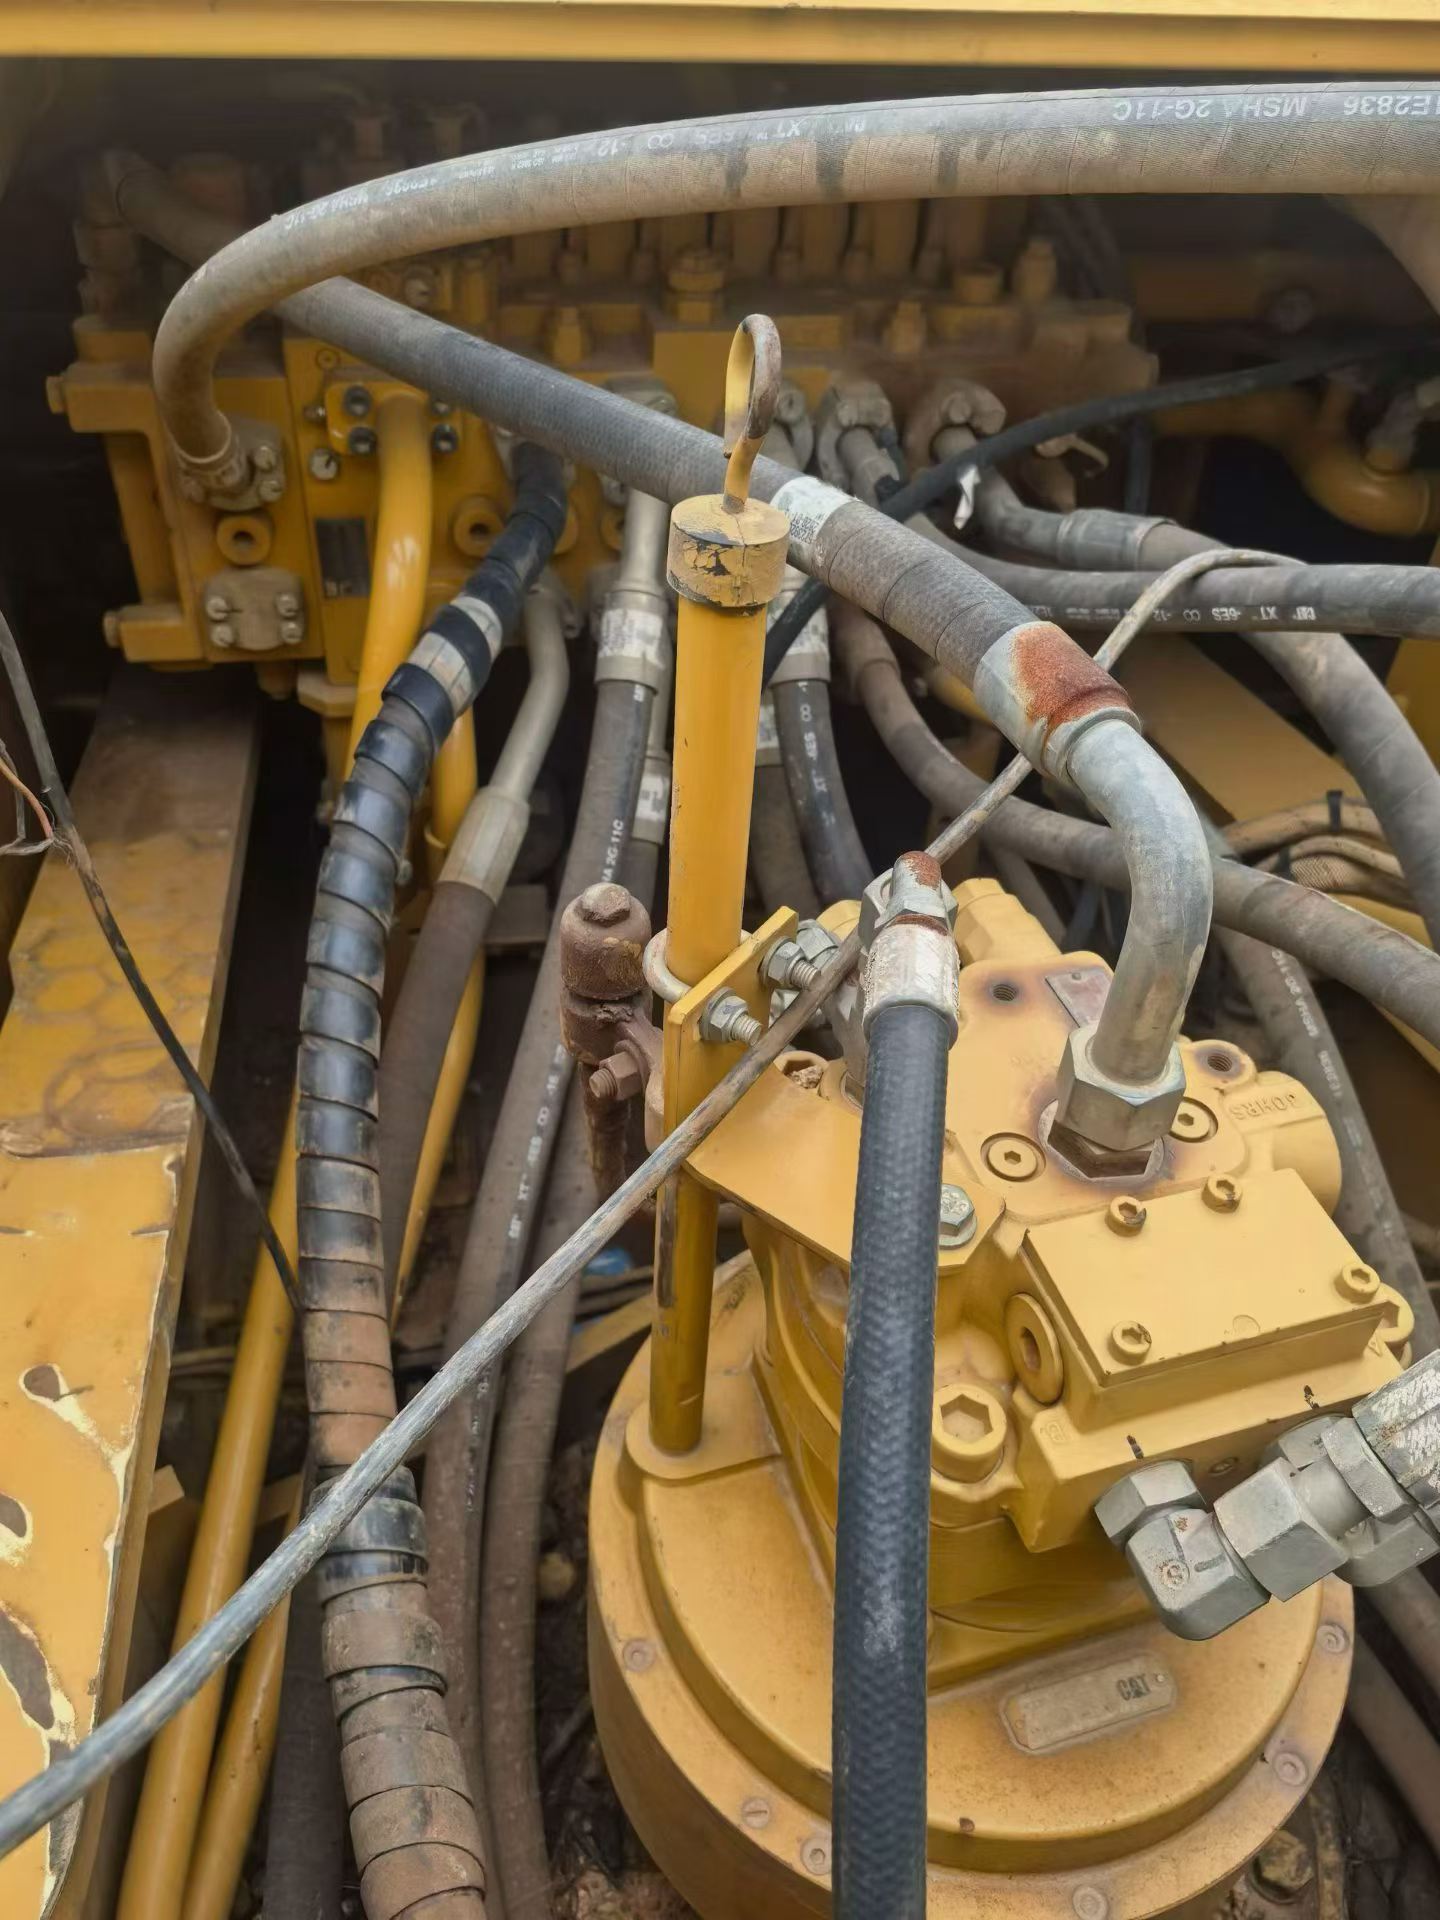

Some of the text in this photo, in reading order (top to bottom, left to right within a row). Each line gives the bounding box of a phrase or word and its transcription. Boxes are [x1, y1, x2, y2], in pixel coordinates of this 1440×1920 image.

[1113, 97, 1210, 121] 2G-11C
[1224, 95, 1308, 118] MSHA
[1118, 1674, 1151, 1702] CAT
